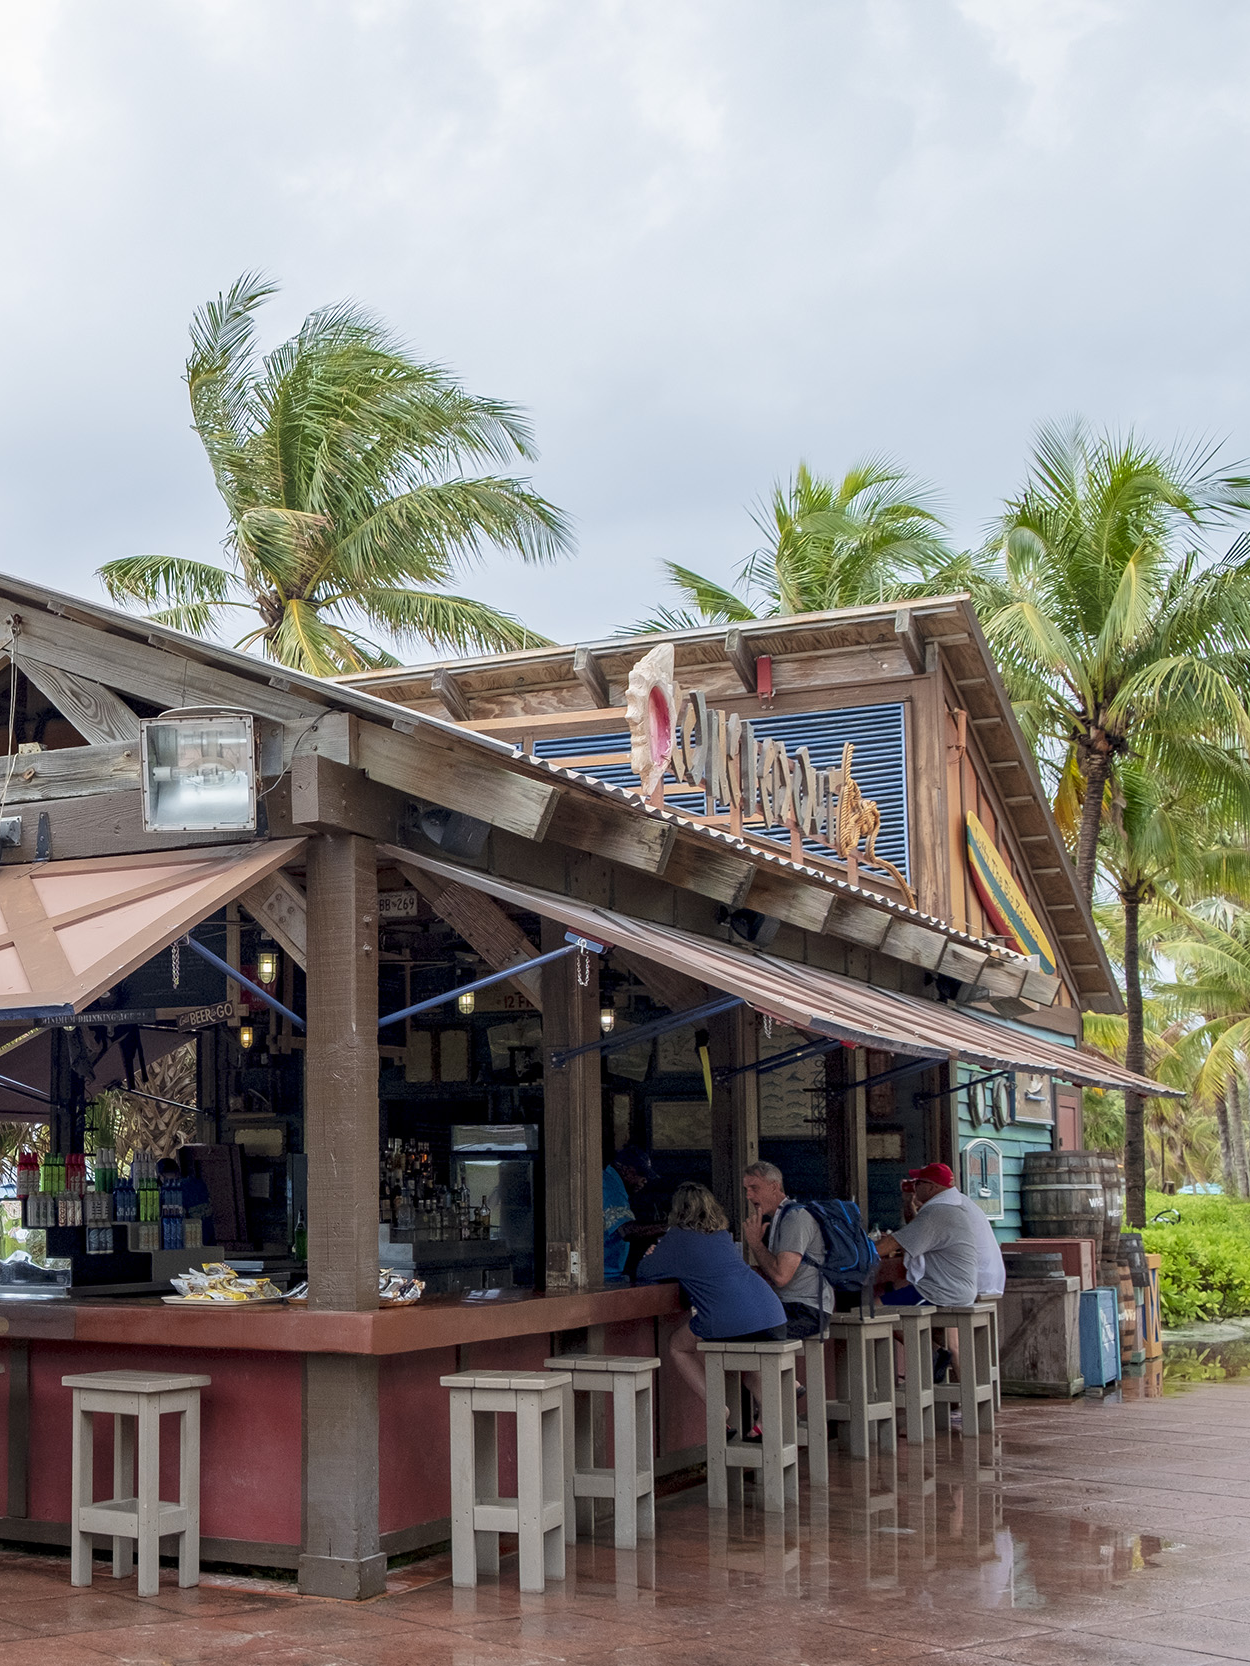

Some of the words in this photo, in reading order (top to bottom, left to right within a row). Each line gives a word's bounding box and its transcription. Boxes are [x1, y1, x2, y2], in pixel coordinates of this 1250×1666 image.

[397, 897, 414, 911] 269
[78, 1012, 116, 1023] DRINKING
[189, 1008, 216, 1025] BEER
[216, 1003, 233, 1018] GO
